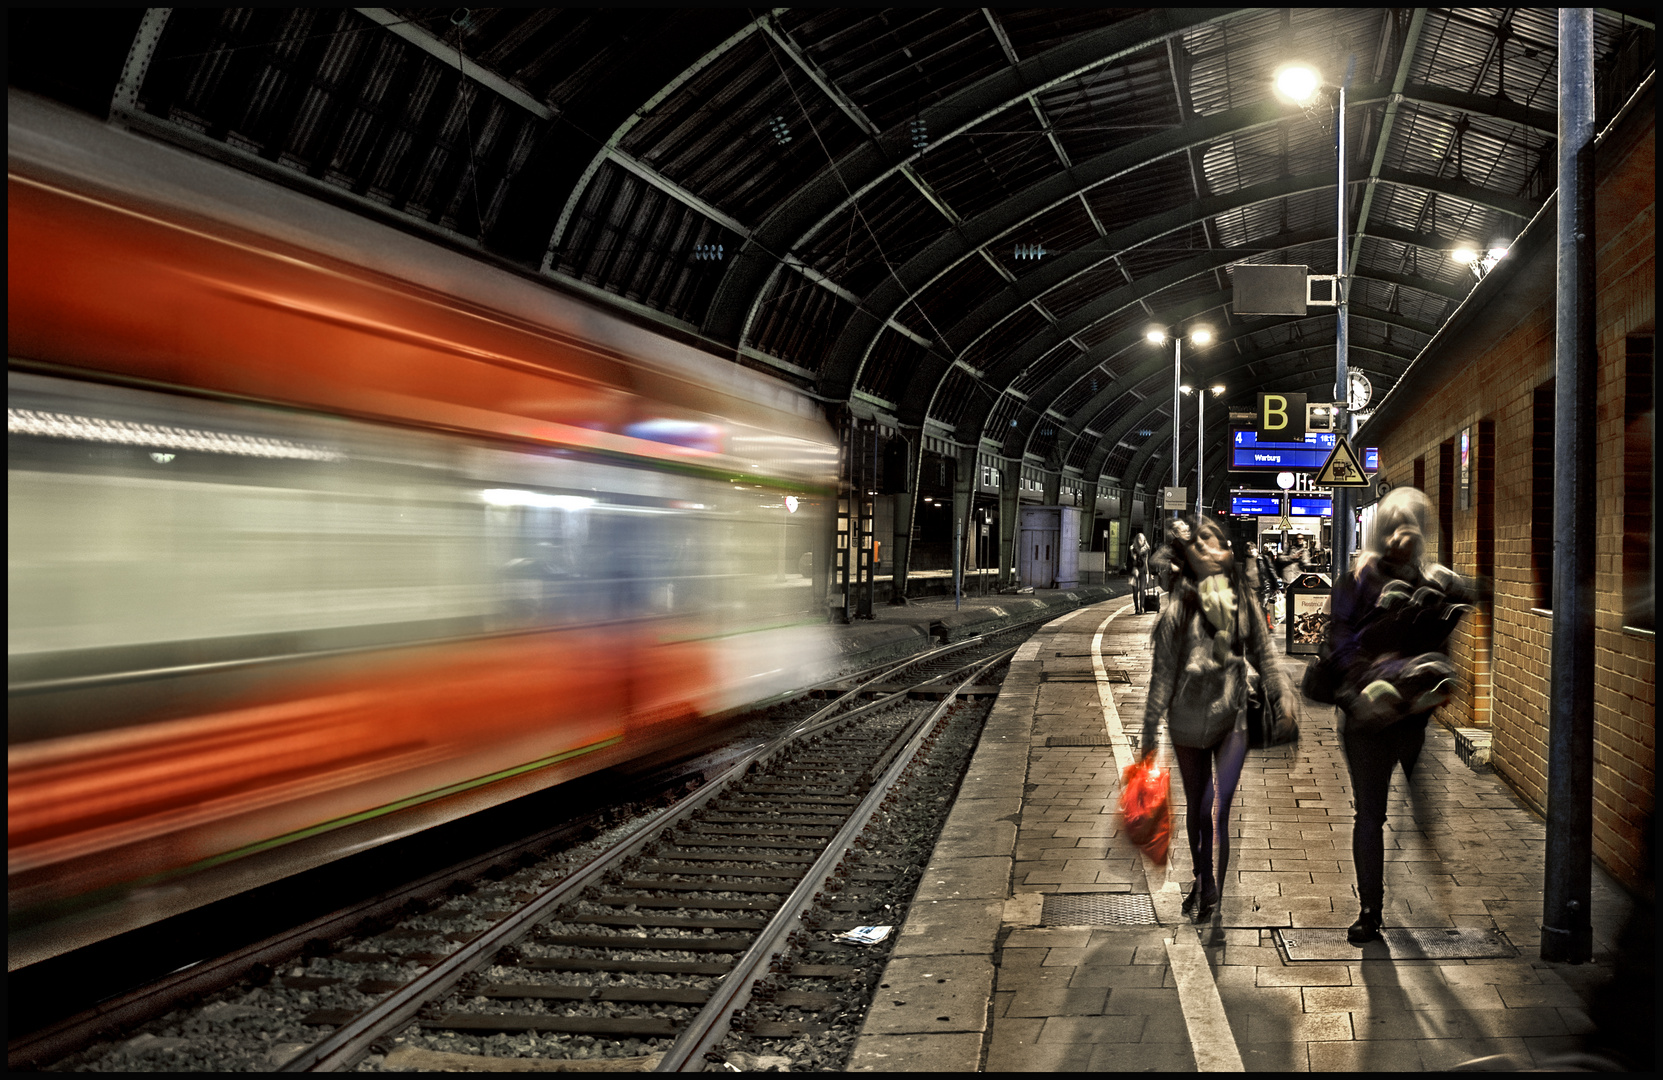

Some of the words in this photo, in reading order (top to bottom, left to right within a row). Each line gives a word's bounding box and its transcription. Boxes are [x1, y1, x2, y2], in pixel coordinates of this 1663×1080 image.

[1264, 395, 1289, 430] B
[1235, 432, 1243, 444] 4
[1254, 454, 1281, 463] Warburg
